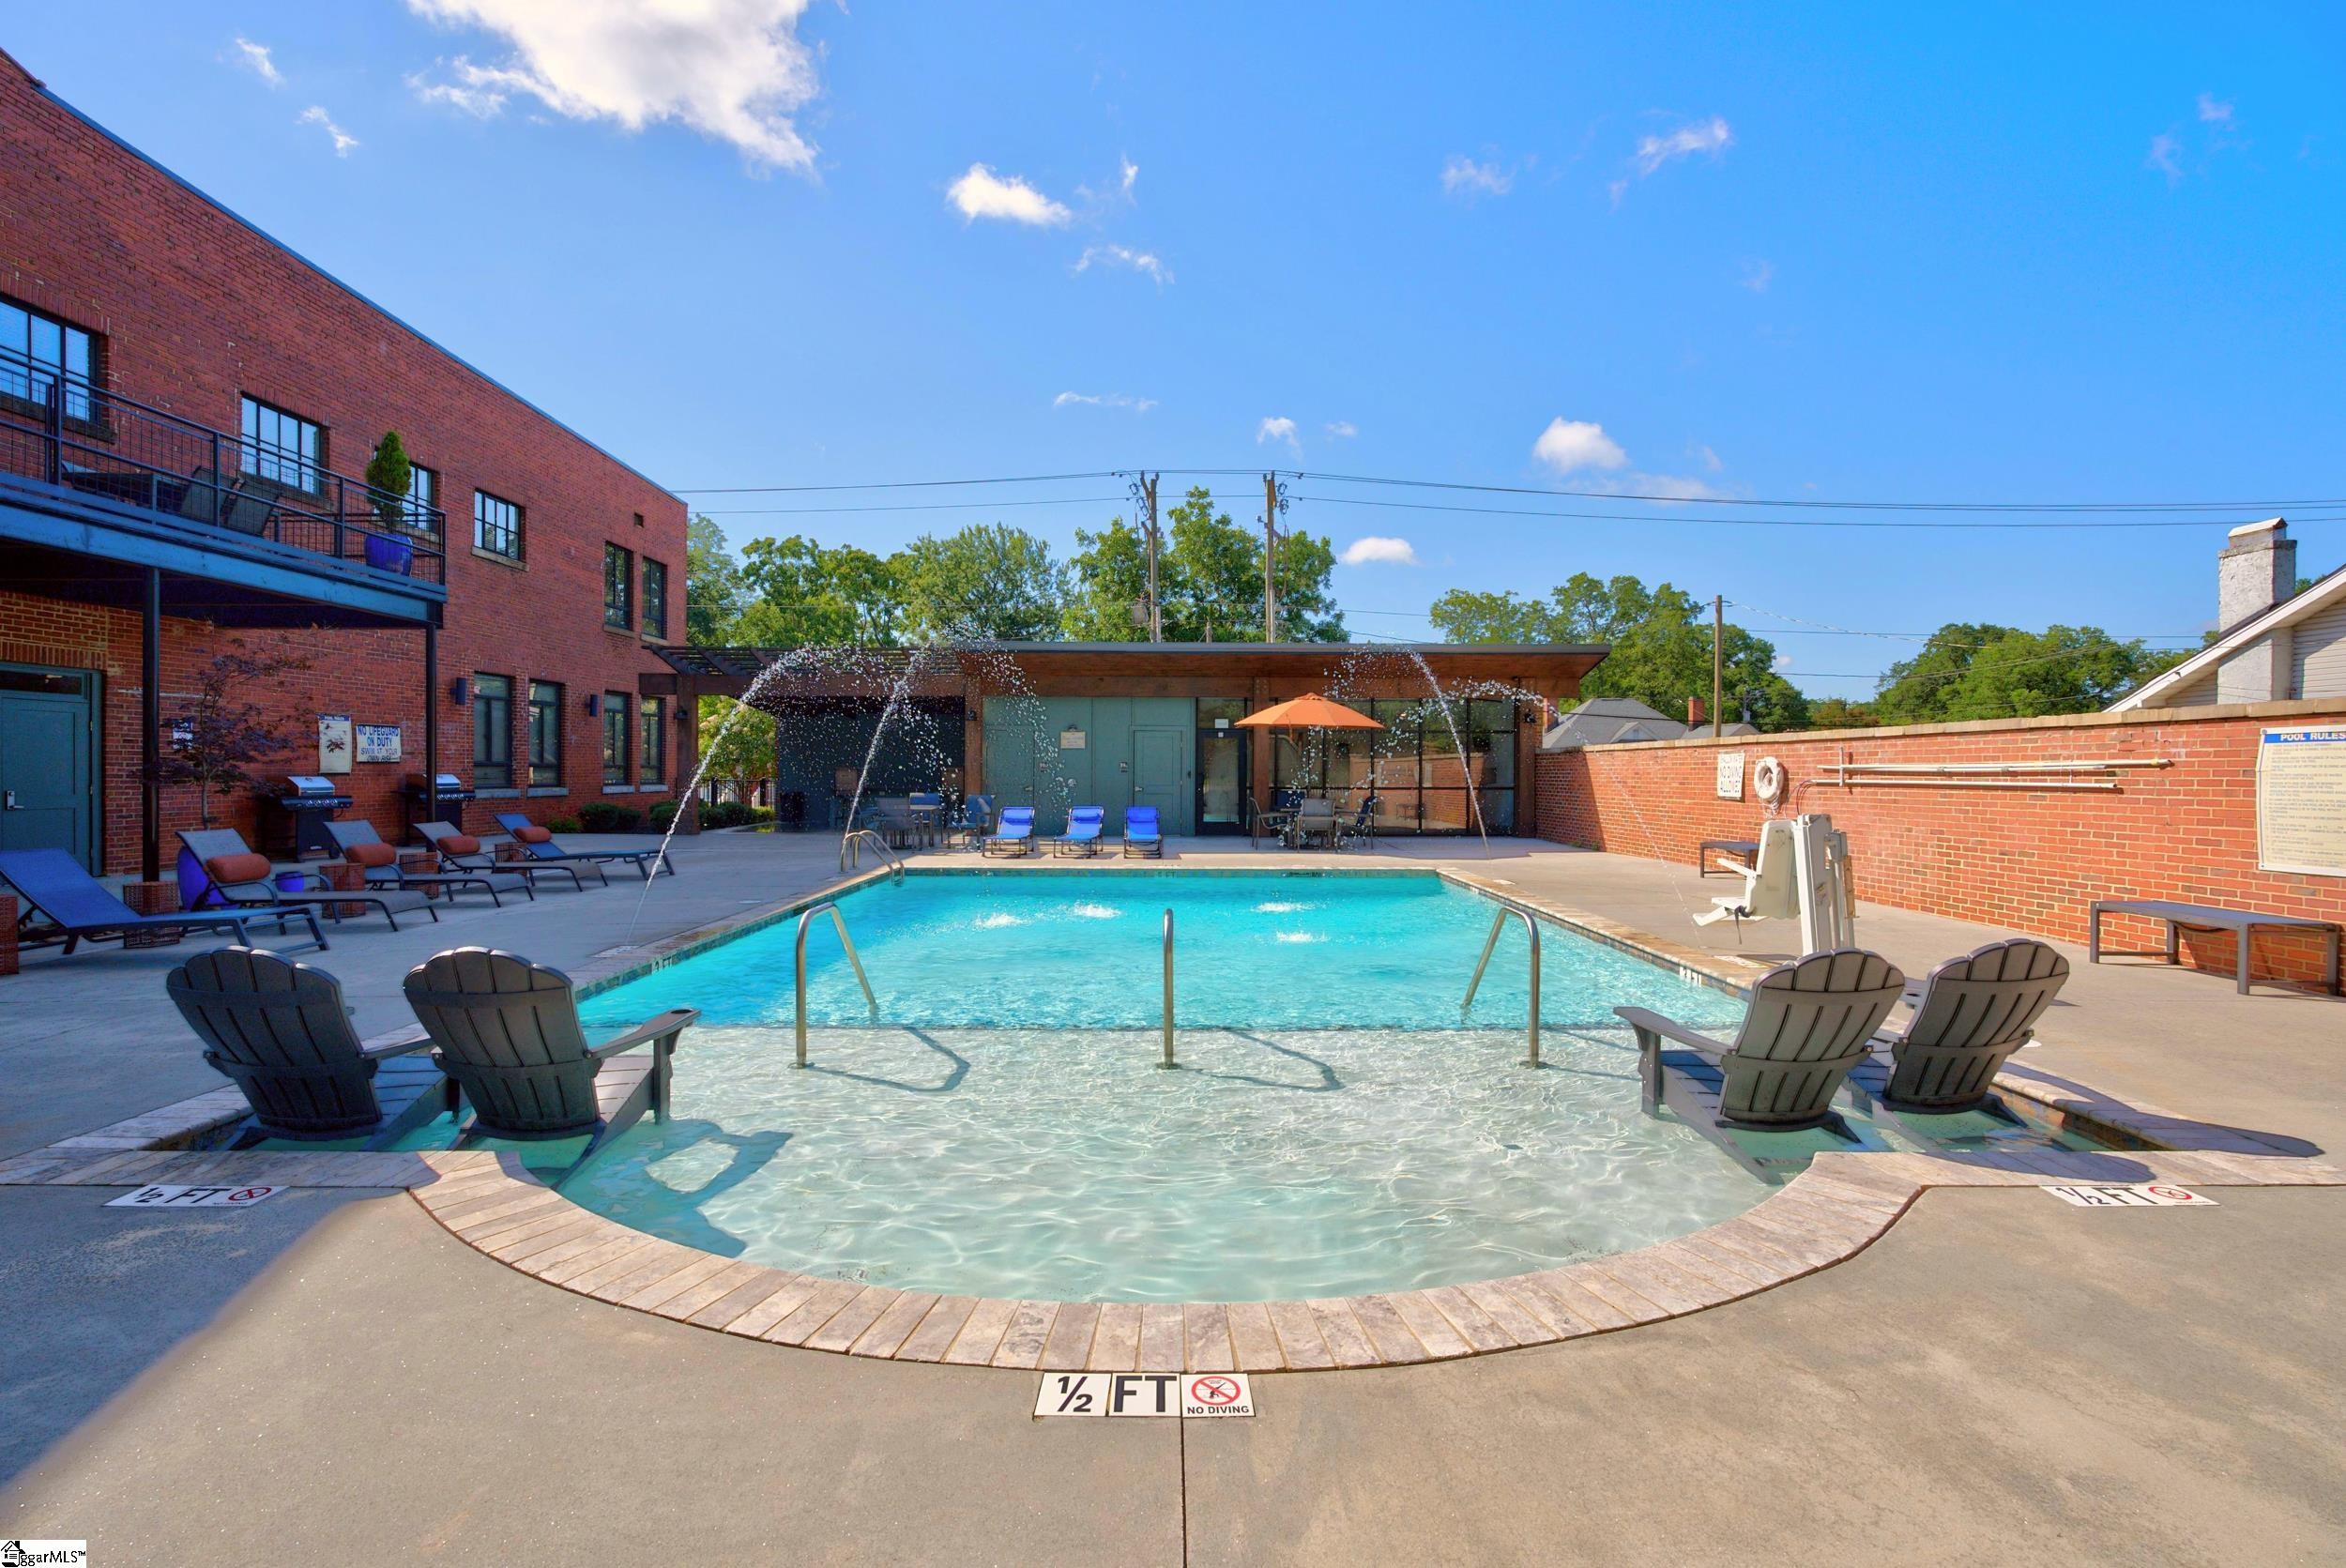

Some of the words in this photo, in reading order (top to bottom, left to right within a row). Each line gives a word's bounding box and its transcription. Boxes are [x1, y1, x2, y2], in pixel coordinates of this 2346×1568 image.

[358, 726, 367, 736] NO
[369, 726, 399, 737] LIFEGUARD
[2310, 732, 2346, 740] RULES
[367, 737, 375, 747] ON
[377, 737, 392, 747] DUTY
[163, 1188, 232, 1203] FT
[2092, 1187, 2158, 1205] FT
[1113, 1376, 1177, 1412] FT
[1187, 1407, 1204, 1415] NO
[1208, 1406, 1249, 1414] DIVING
